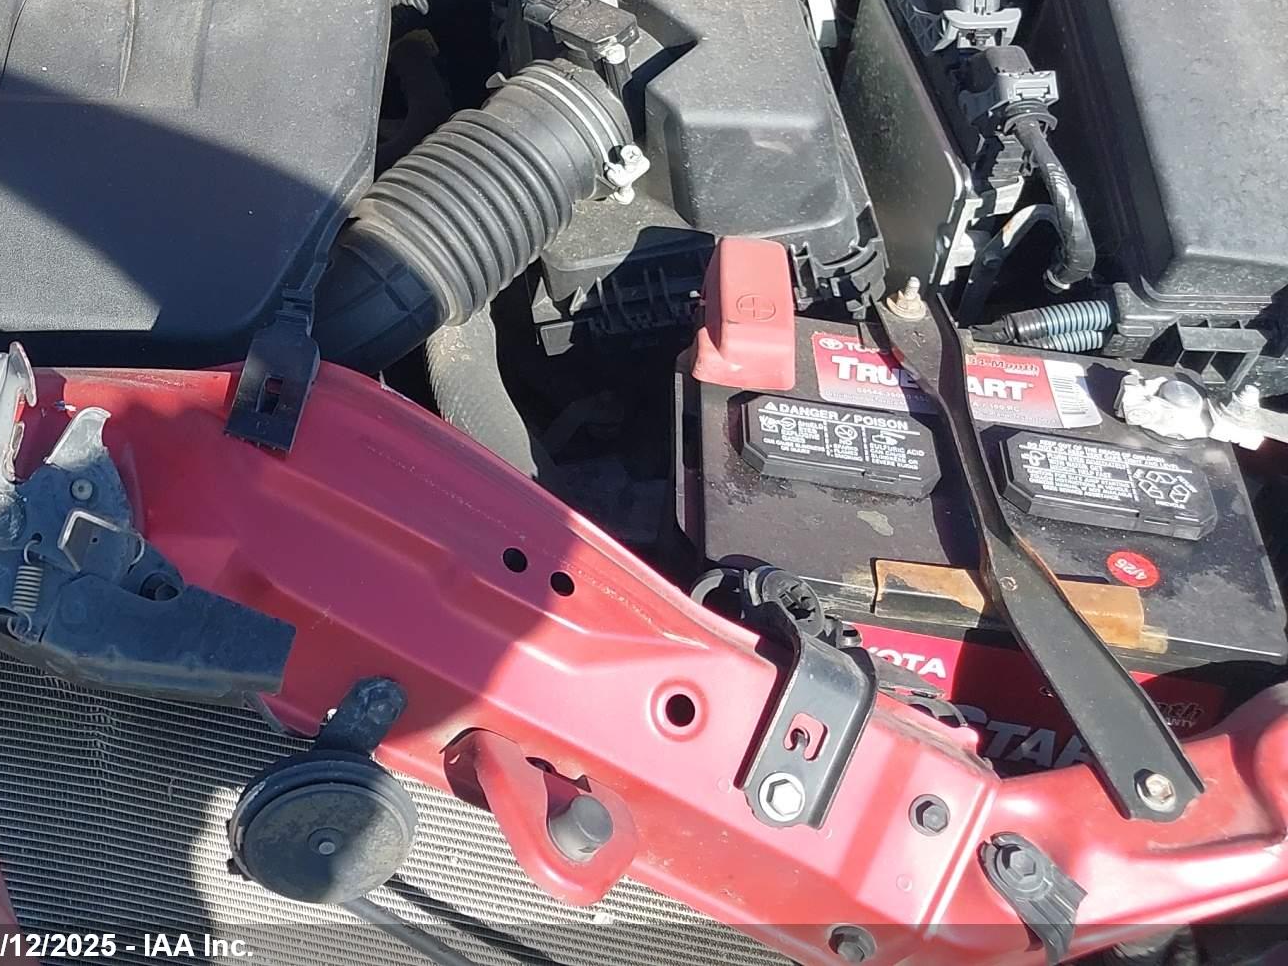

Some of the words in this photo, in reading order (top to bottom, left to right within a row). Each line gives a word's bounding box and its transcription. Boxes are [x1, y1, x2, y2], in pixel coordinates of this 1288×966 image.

[967, 374, 1024, 401] ART
[779, 403, 839, 421] DANGER
[853, 413, 909, 431] POISON
[906, 449, 925, 457] ACID
